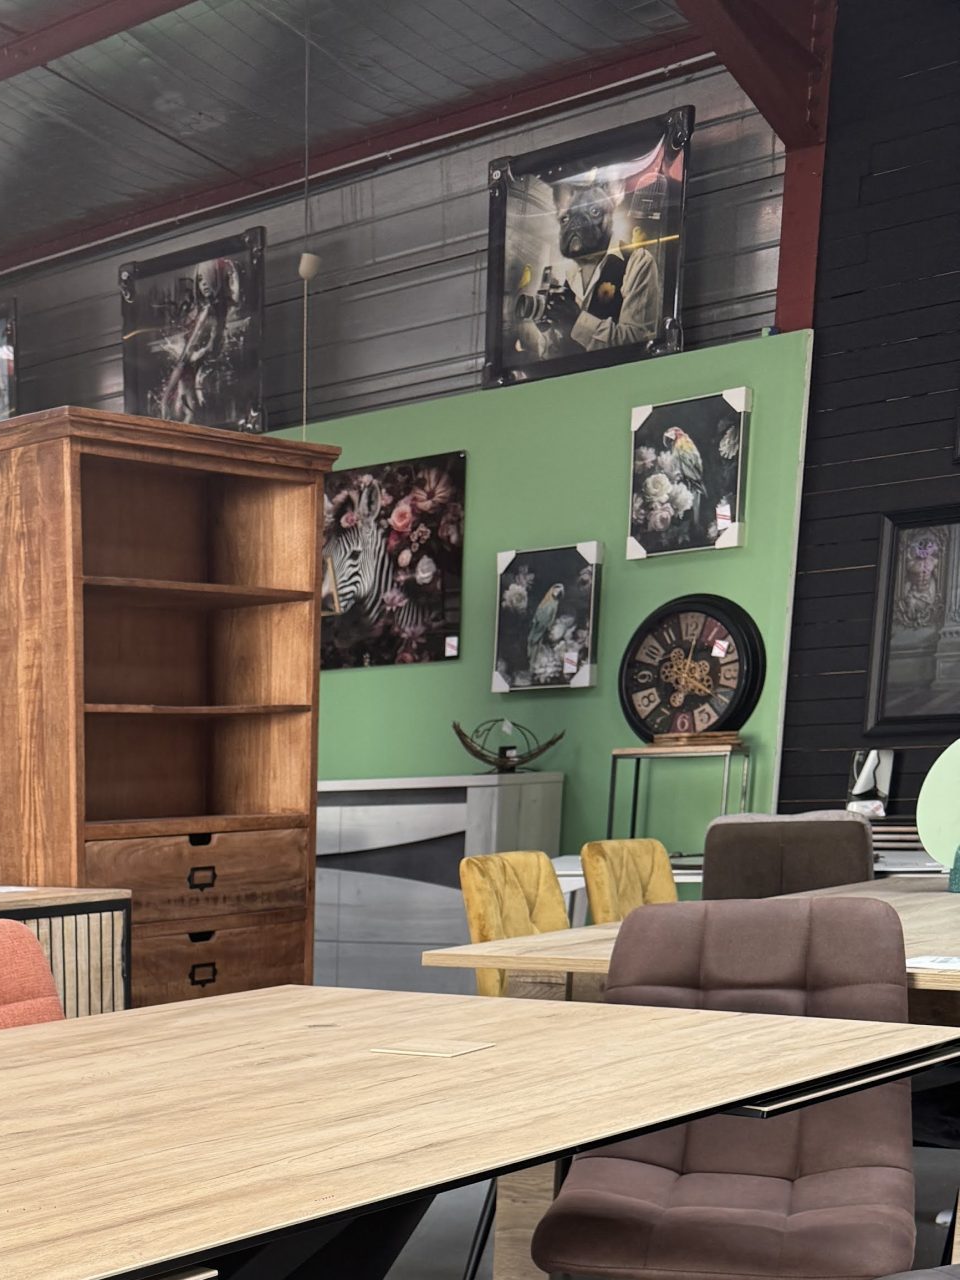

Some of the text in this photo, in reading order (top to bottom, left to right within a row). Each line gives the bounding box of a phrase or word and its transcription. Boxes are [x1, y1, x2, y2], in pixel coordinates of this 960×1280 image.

[663, 628, 676, 644] 11
[684, 622, 699, 637] 12
[708, 627, 719, 641] 1
[641, 692, 657, 708] 8
[676, 713, 689, 731] 6
[697, 707, 711, 724] 5
